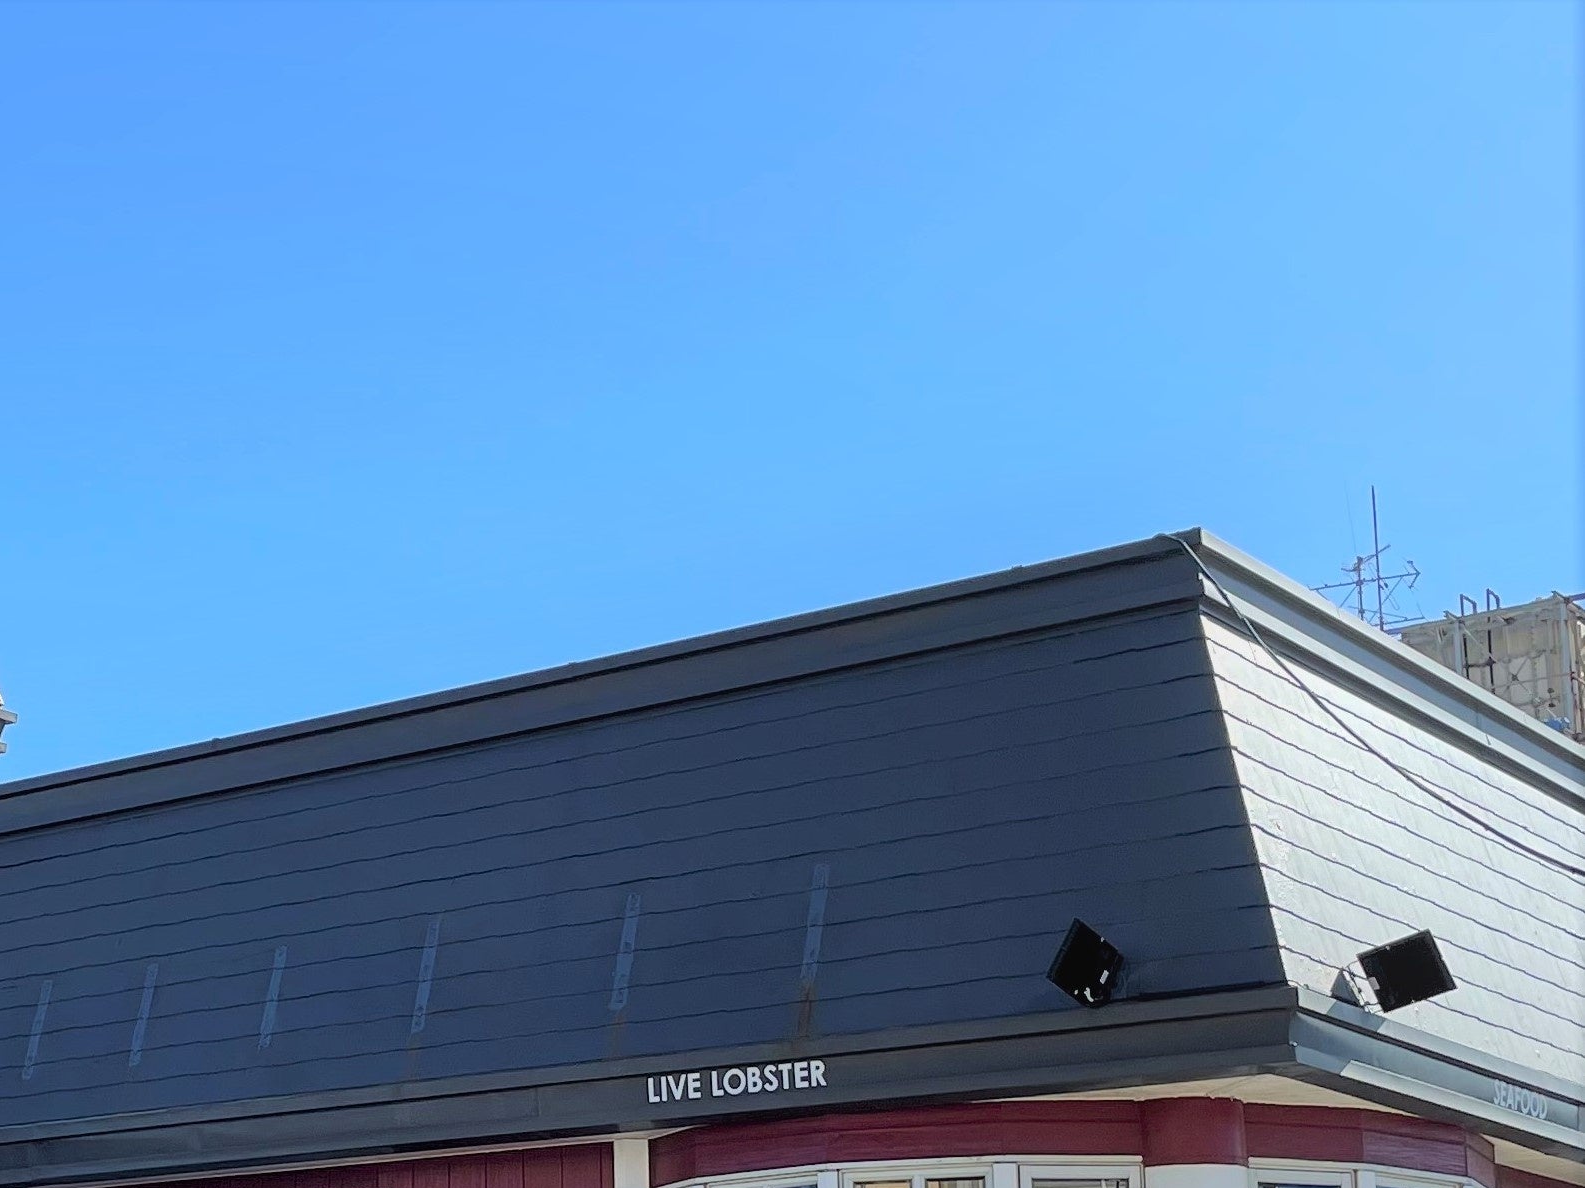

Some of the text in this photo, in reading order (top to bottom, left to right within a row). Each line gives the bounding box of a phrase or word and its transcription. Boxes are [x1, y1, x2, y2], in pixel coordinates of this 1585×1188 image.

[647, 1060, 827, 1103] LIVE LOBSTER
[1493, 1080, 1548, 1119] SEAFOOD
